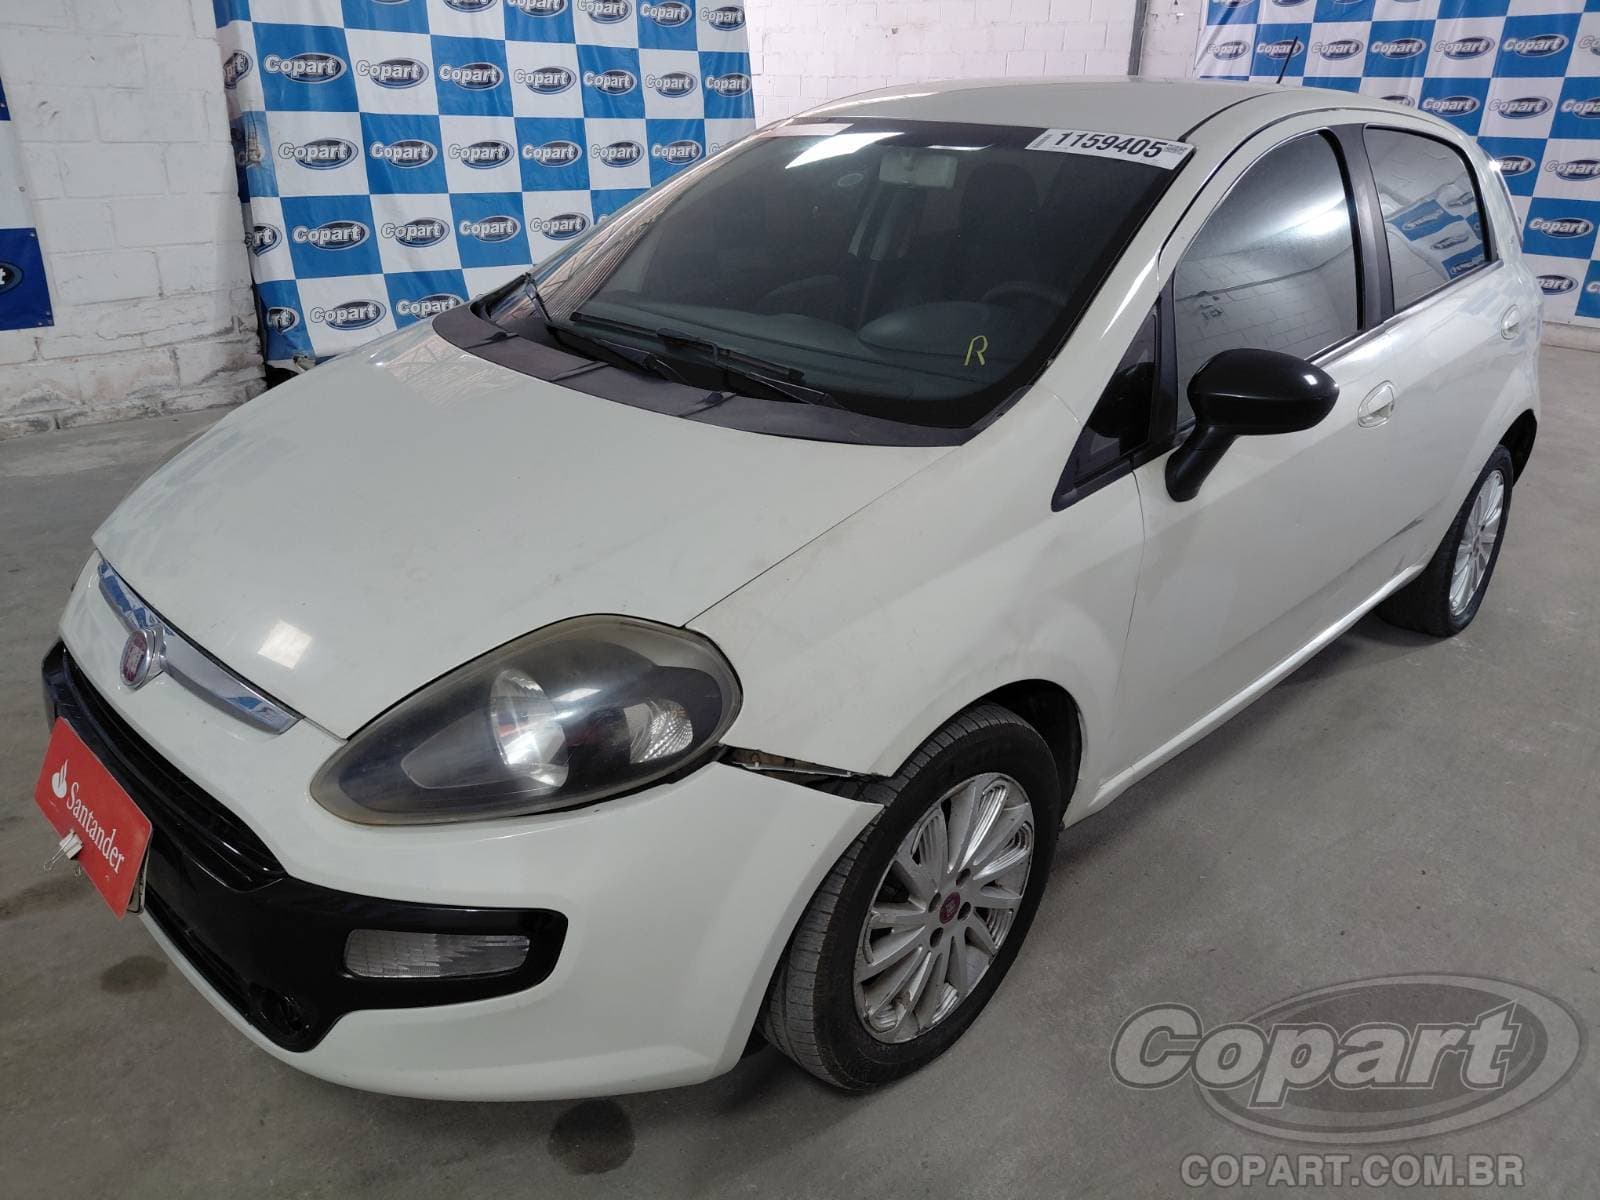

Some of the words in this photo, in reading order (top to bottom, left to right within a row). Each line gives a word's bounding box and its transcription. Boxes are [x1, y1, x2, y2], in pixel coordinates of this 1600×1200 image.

[640, 3, 686, 20] Copart
[700, 8, 743, 22] Copart
[1312, 42, 1358, 56] Copart
[1371, 41, 1418, 55] Copart
[1435, 38, 1490, 53] Copart
[1503, 36, 1562, 53] Copart
[264, 55, 337, 78] Copart
[356, 59, 420, 79] Copart
[439, 64, 498, 84] Copart
[514, 69, 568, 86] Copart
[583, 71, 631, 88] Copart
[645, 74, 690, 91] Copart
[704, 75, 747, 91] Copart
[1422, 97, 1474, 114] Copart
[1488, 98, 1544, 115] Copart
[1561, 99, 1600, 115] Copa
[278, 142, 347, 163] Copart
[370, 141, 429, 161] Copart
[449, 143, 506, 162] Copart
[522, 143, 574, 161] Copart
[591, 144, 638, 160] Copart
[652, 143, 697, 159] Copart
[1055, 131, 1168, 158] 1159405
[381, 219, 440, 240] Copart
[459, 218, 514, 237] Copart
[530, 214, 582, 234] Copart
[1529, 218, 1585, 234] Copart
[293, 223, 361, 244] Copart
[310, 303, 376, 323] Copart
[964, 335, 988, 366] R
[66, 782, 125, 875] Santander
